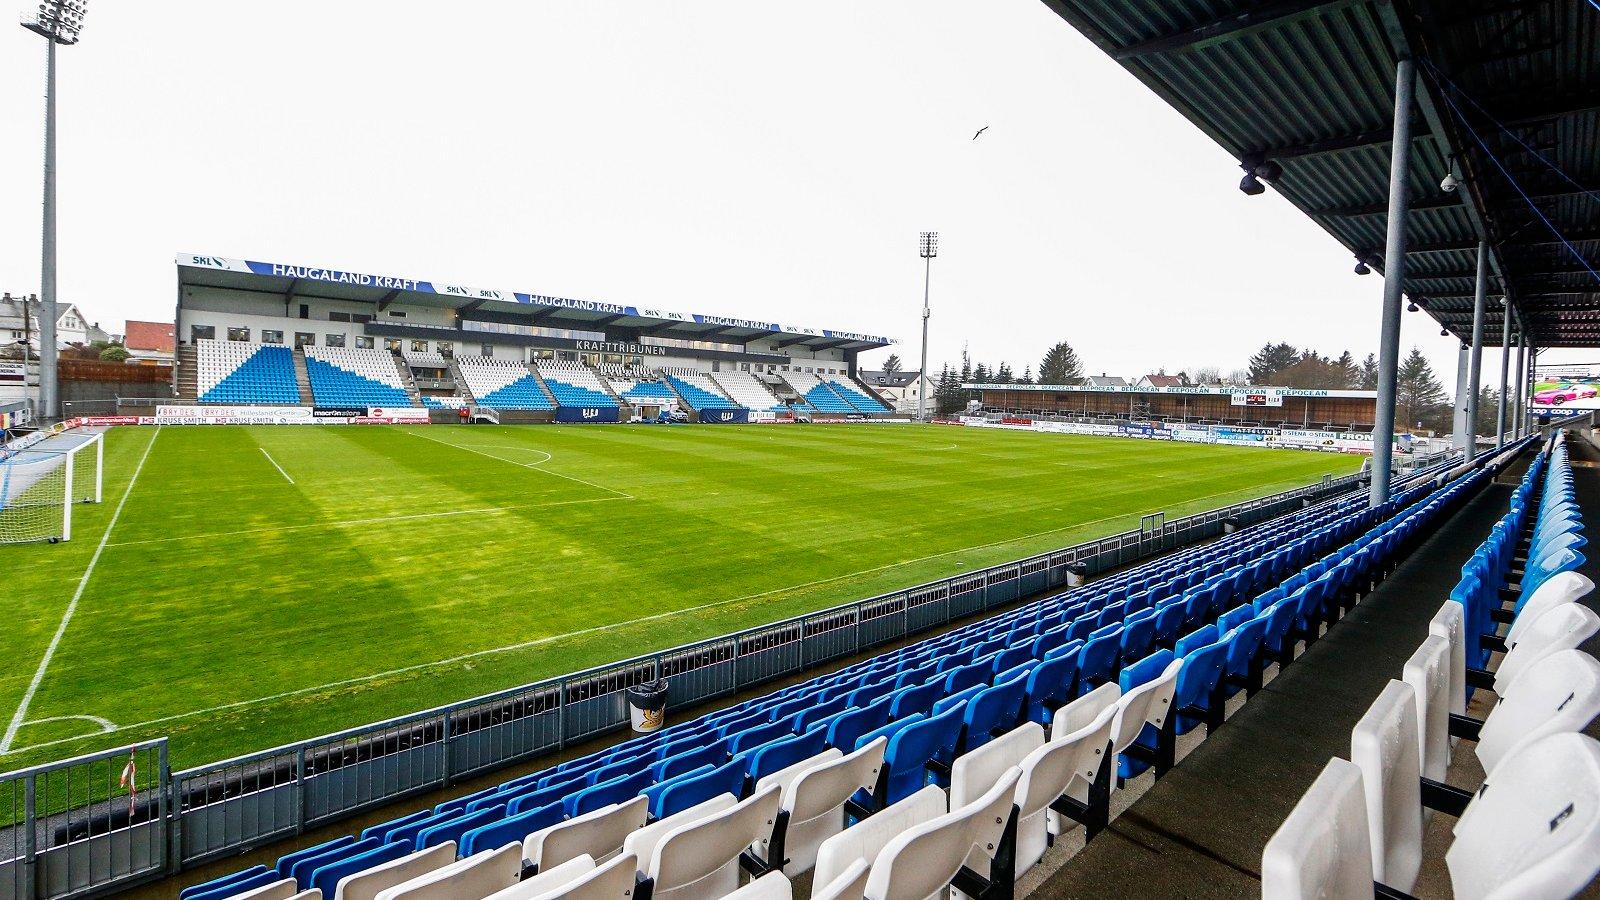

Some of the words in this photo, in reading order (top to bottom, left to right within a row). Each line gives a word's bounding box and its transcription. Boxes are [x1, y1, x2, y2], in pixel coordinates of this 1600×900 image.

[192, 256, 212, 266] SKL
[272, 263, 371, 285] HAUGALAND
[375, 276, 419, 291] KRAFT
[446, 286, 460, 294] SKL
[479, 289, 493, 298] SKL
[528, 294, 594, 311] HAUGALAND
[596, 301, 626, 314] KRAFT
[702, 315, 749, 328] HAUGALAND
[750, 320, 771, 330] KRAFT
[831, 330, 866, 341] HAUGALAND
[576, 340, 666, 356] KRAFTTRIBUNEN
[1217, 432, 1242, 440] Bavaria
[1340, 432, 1374, 441] FRON
